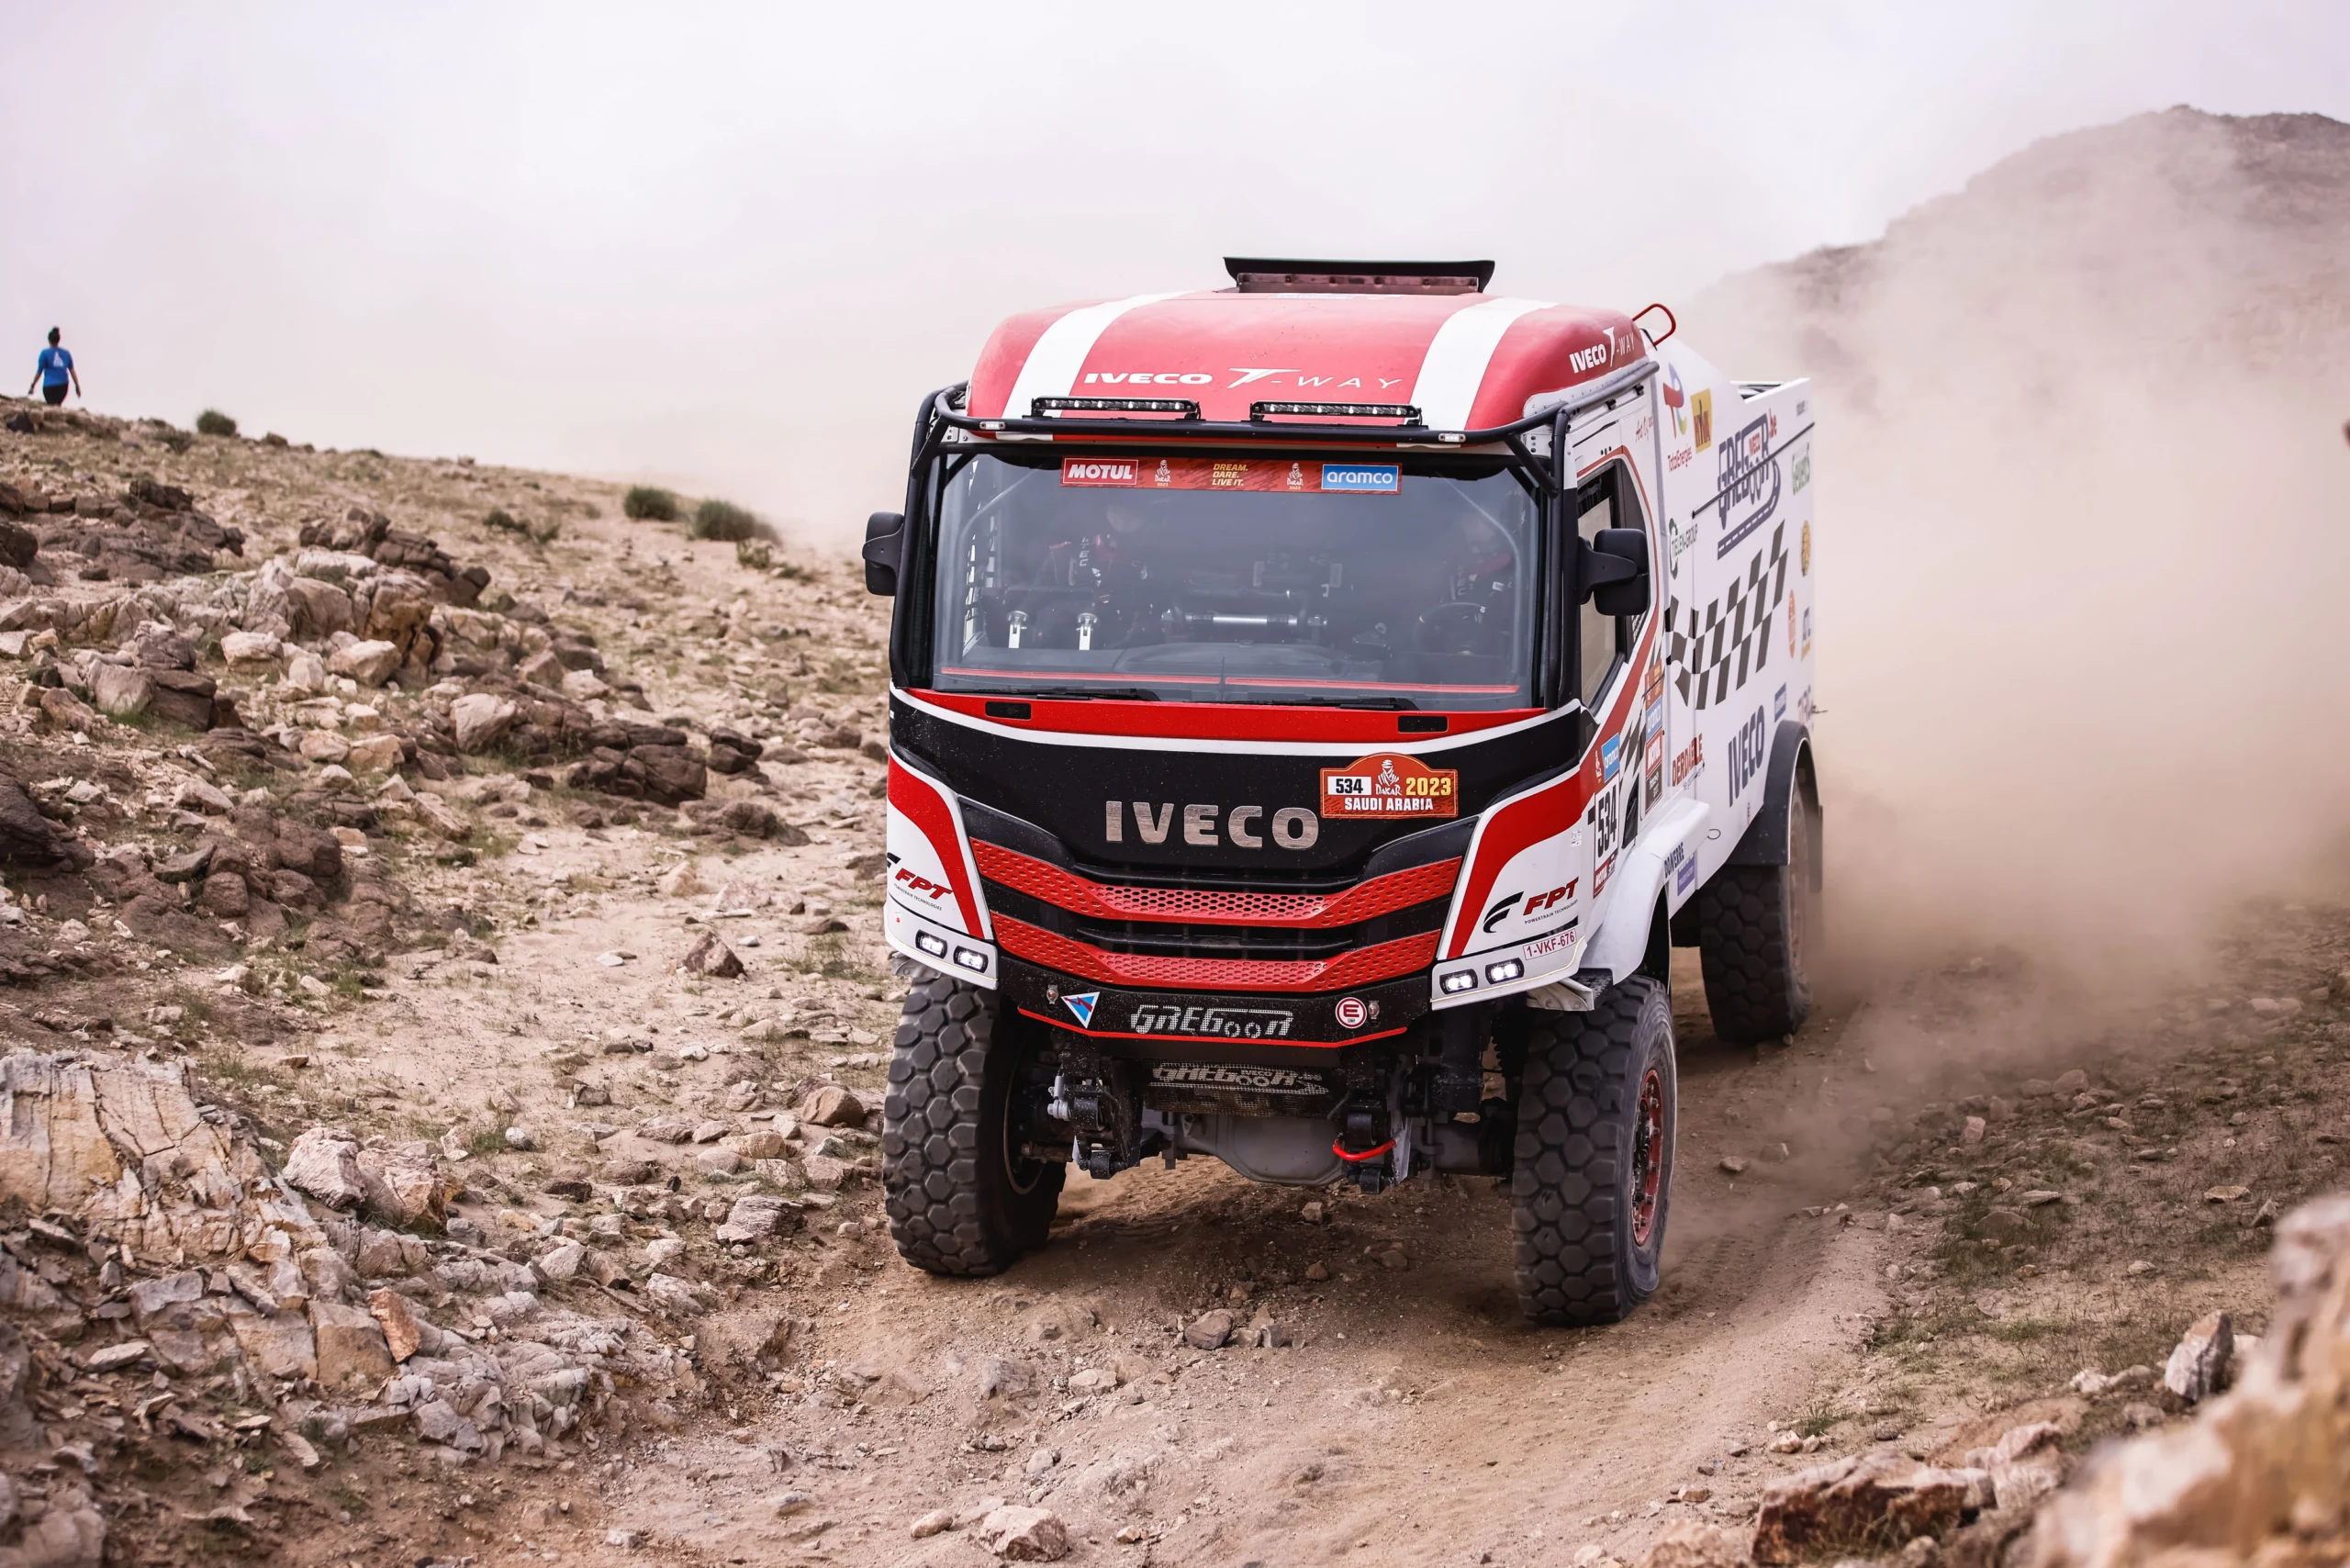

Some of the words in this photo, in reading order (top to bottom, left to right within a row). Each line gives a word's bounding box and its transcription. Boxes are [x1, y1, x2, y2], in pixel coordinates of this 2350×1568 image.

[1569, 343, 1606, 374] IVECO
[1084, 373, 1213, 385] IVECO
[1068, 464, 1133, 479] MOTUL
[1326, 471, 1393, 485] aramco
[1605, 746, 1618, 769] aramco
[1729, 705, 1764, 808] IVECO
[1336, 778, 1363, 794] 534
[1405, 778, 1451, 796] 2023
[1345, 797, 1382, 811] SAUDI
[1386, 798, 1434, 811] ARABIA
[1105, 801, 1319, 850] IVECO
[1597, 784, 1617, 858] 534
[895, 868, 954, 900] FPT
[1523, 876, 1579, 916] FPT
[1525, 912, 1554, 924] POWERTRAIN
[1527, 931, 1575, 958] 1-VKF-676
